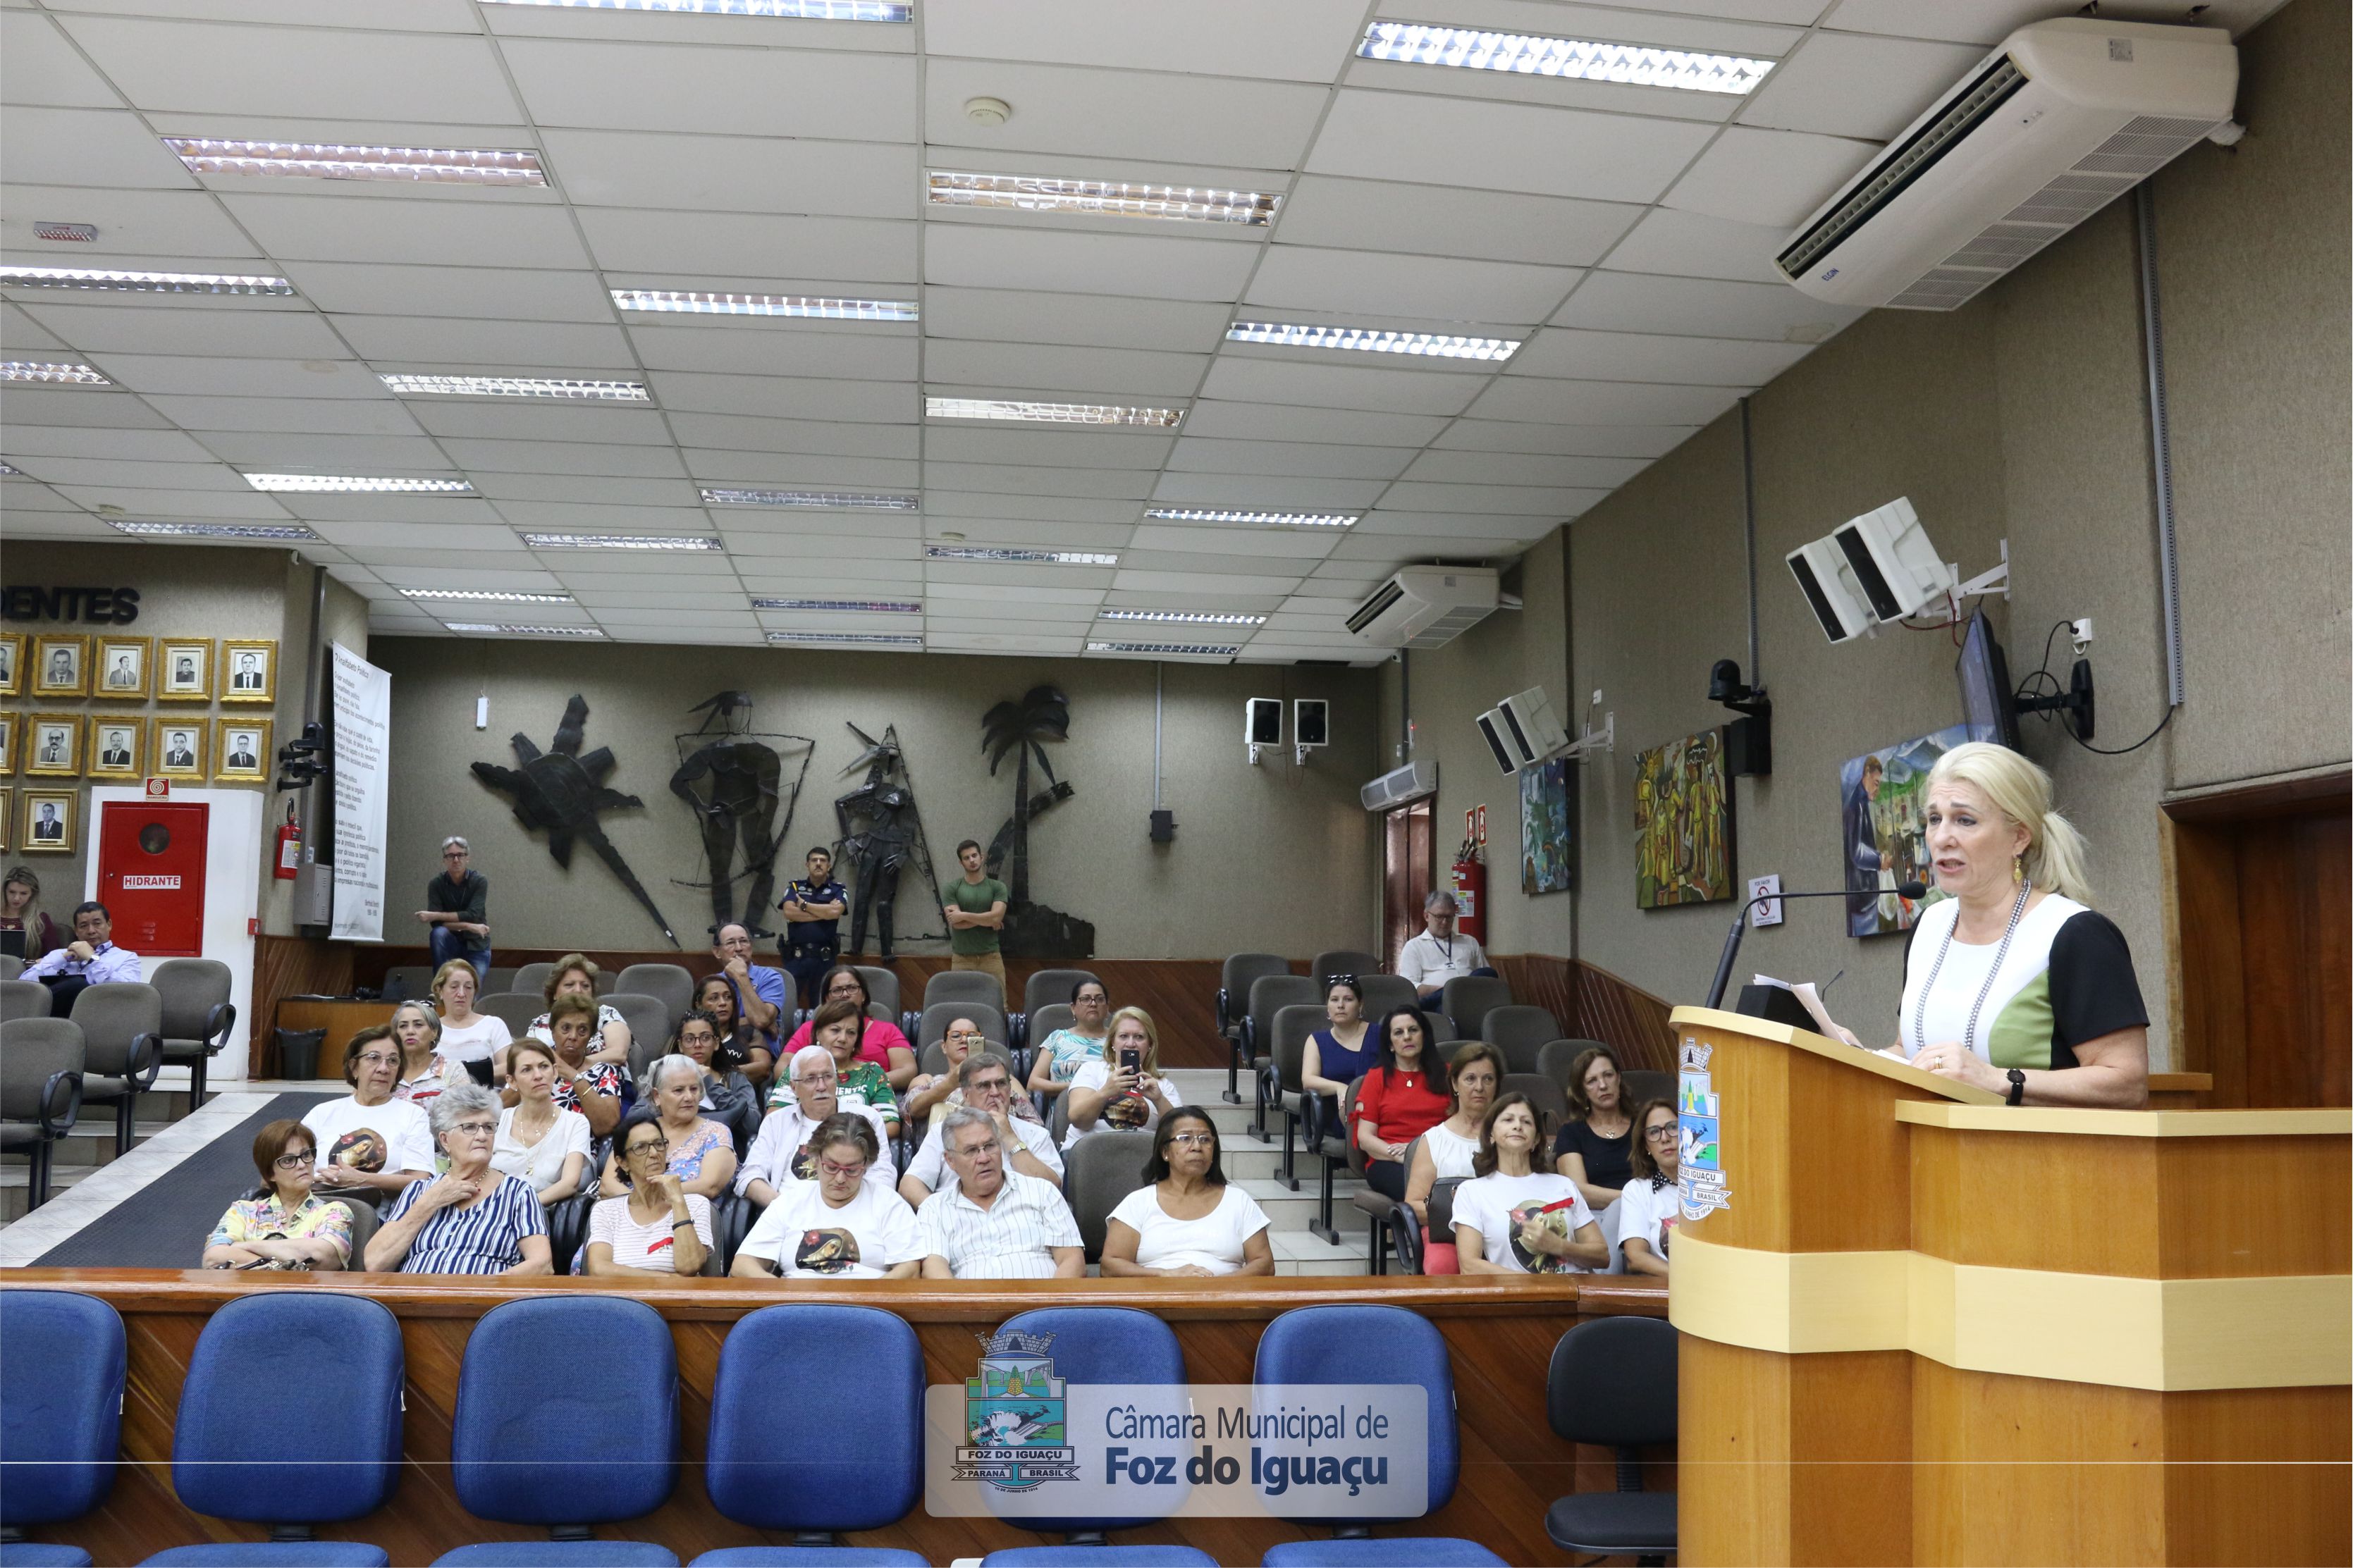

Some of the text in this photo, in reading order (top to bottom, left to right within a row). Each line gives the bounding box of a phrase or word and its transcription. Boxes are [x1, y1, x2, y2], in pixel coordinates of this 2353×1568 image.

[0, 586, 141, 622] ENTES
[125, 877, 180, 886] HIDRANTE
[1690, 1171, 1716, 1183] IGUAÇU
[1697, 1192, 1717, 1201] BRASIL
